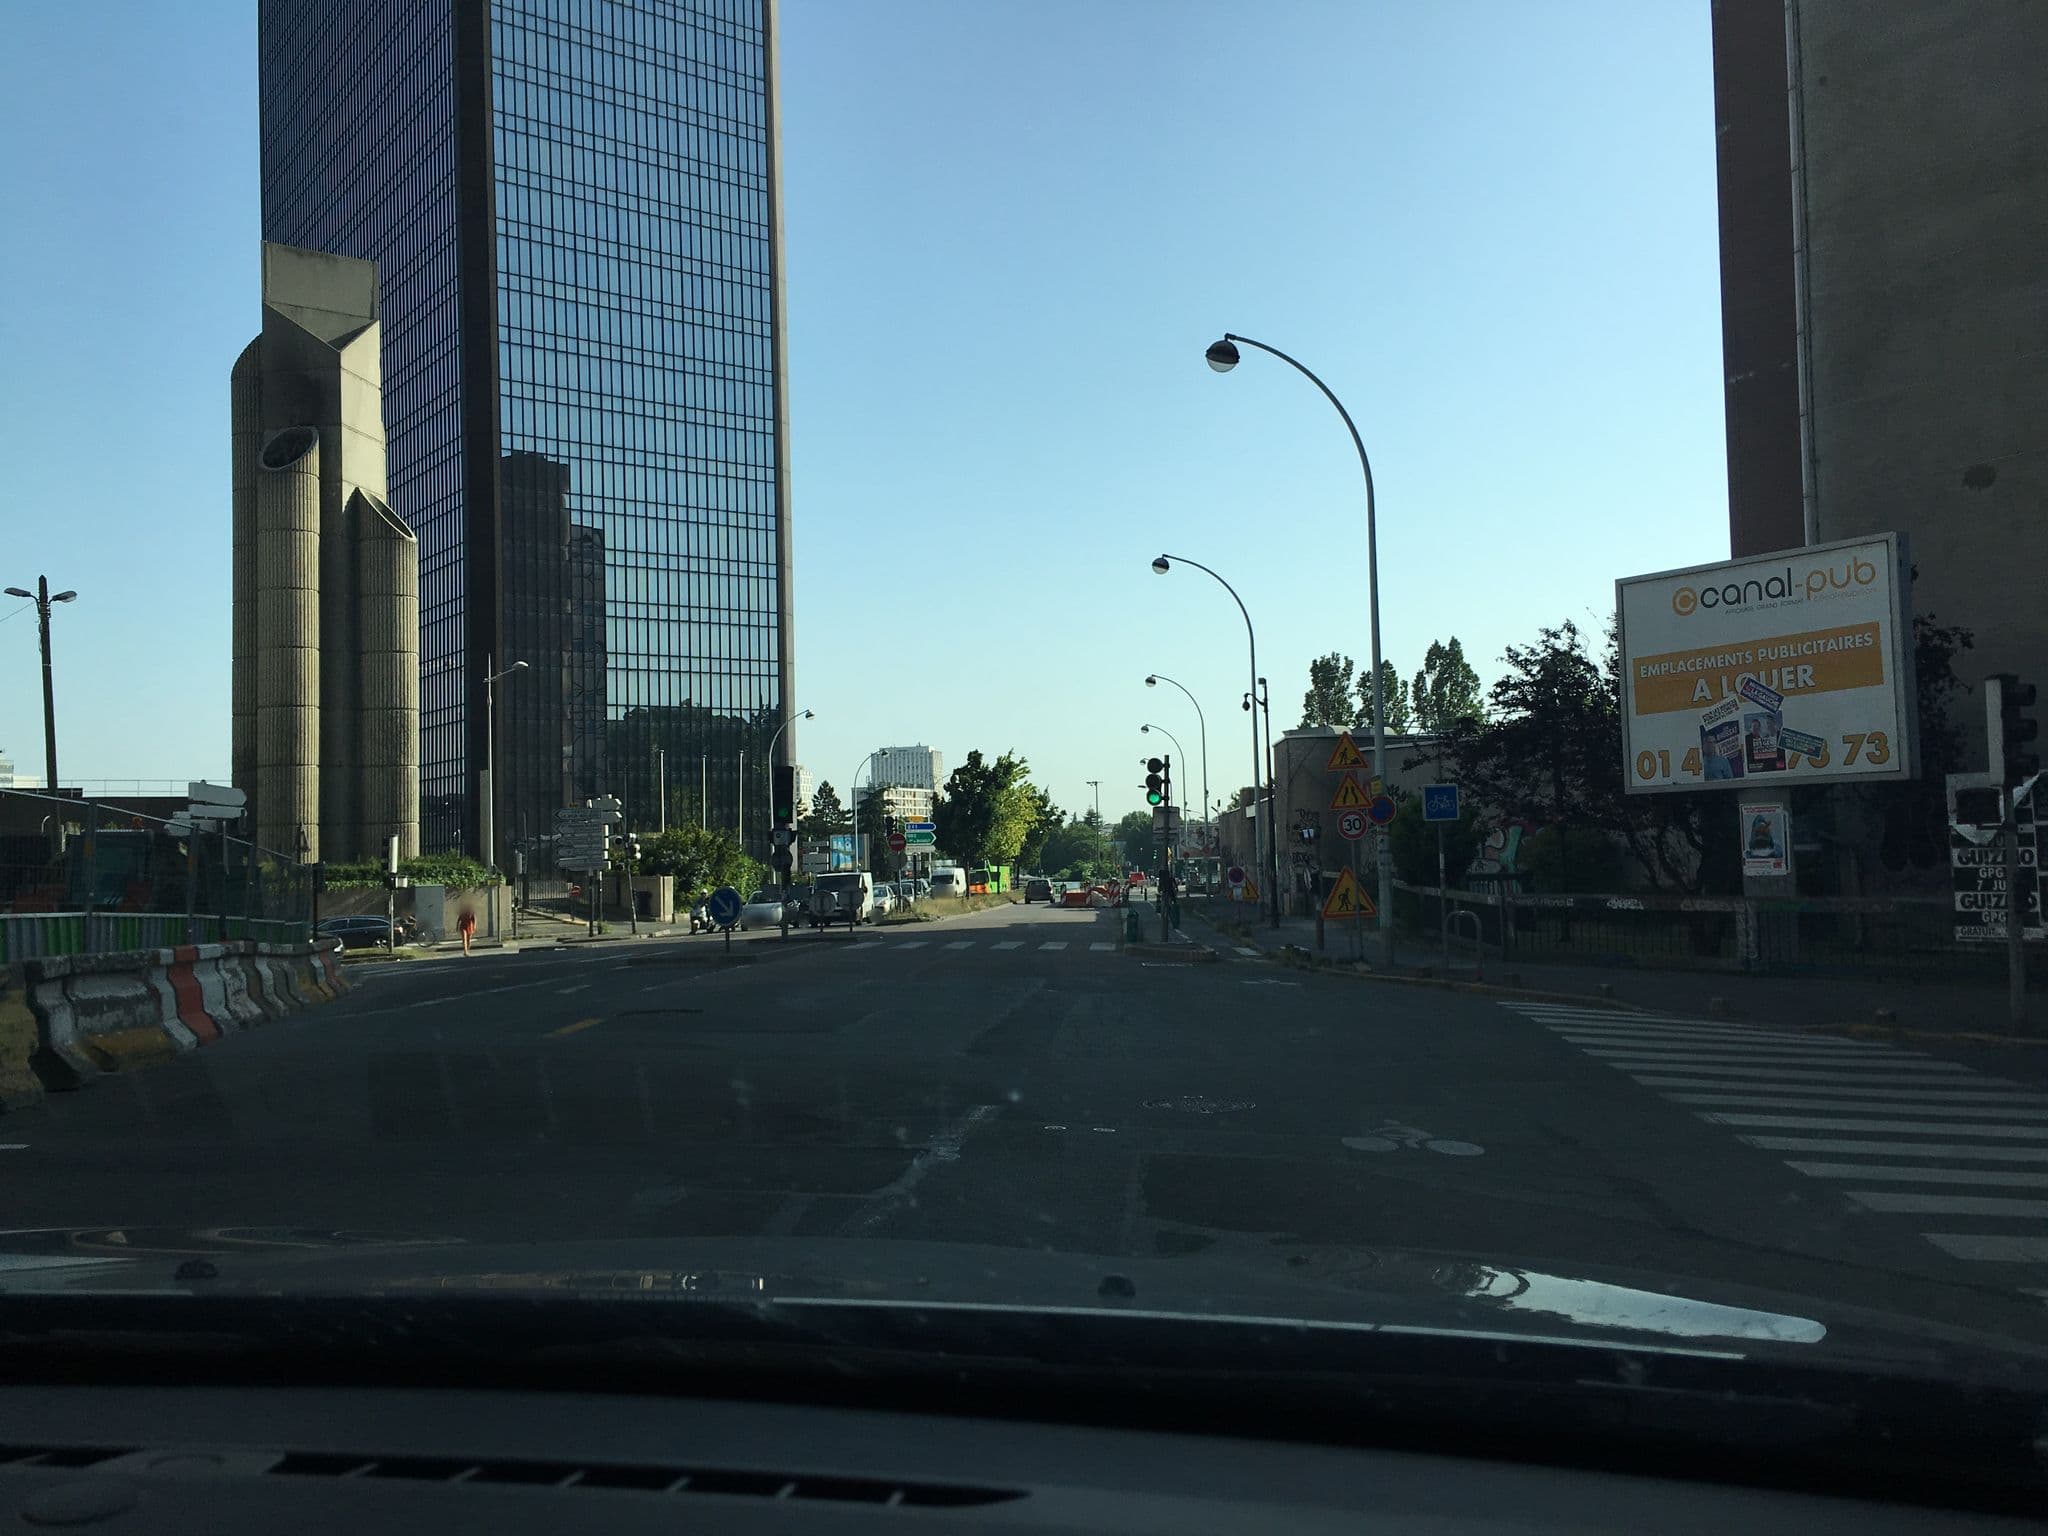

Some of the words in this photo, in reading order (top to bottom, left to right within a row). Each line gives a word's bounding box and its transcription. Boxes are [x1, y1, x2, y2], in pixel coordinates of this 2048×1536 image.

[1700, 556, 1876, 608] canal-pub
[1640, 651, 1753, 679] EMPLACEMENTS
[1758, 632, 1874, 661] PUBLICITAIRES
[1692, 678, 1713, 703] A
[1636, 749, 1670, 780] 01
[1842, 732, 1890, 766] 73
[1343, 818, 1362, 832] 30
